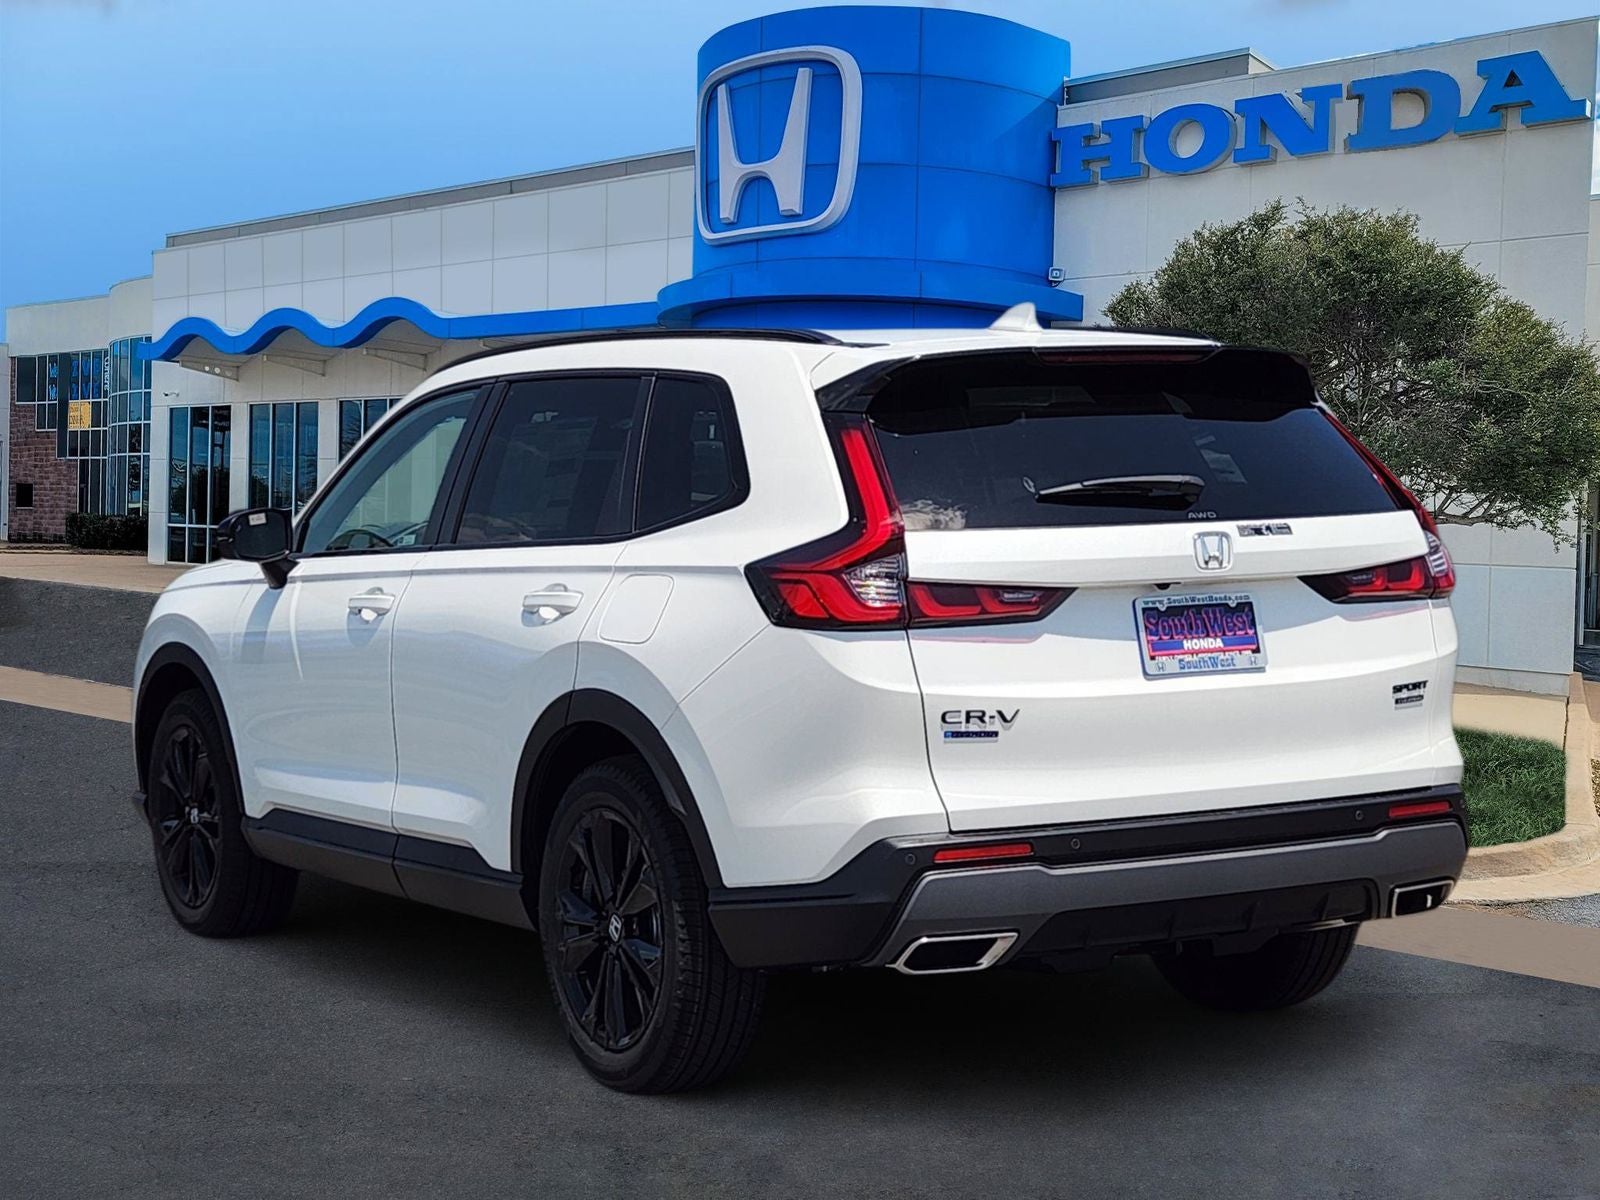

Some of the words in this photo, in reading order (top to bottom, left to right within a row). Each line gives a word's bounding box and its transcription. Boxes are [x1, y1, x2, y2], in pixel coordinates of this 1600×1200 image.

[1051, 50, 1591, 188] HONDA
[1188, 511, 1217, 519] AWD
[1144, 606, 1255, 641] SouthWest
[1183, 638, 1225, 651] HONDA
[1178, 656, 1237, 671] SouthWest
[1392, 680, 1429, 694] SPORT
[940, 708, 1021, 725] CR-V
